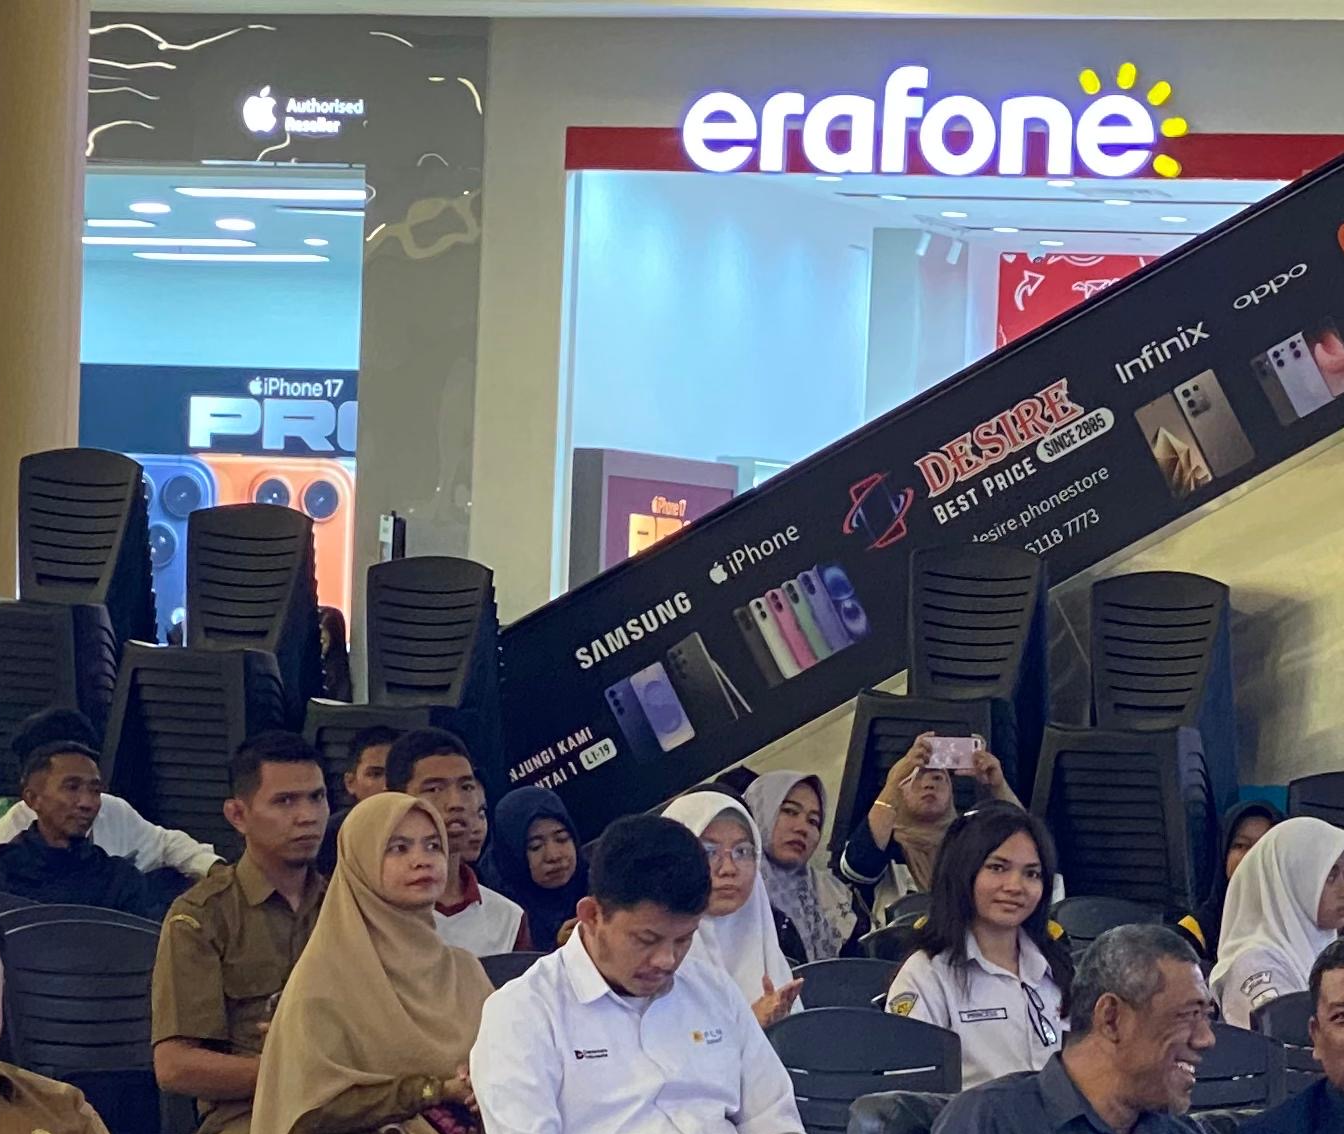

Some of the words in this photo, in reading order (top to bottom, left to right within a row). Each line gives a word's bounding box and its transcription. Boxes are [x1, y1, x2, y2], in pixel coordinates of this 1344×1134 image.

[286, 98, 364, 114] Authorised
[683, 66, 1154, 177] erafone
[1115, 322, 1210, 384] Infinix
[263, 378, 323, 397] iPhone
[324, 379, 344, 397] 17
[914, 377, 1084, 498] DESIRE
[1043, 428, 1076, 457] SINCE
[933, 488, 979, 525] BEST
[982, 457, 1037, 498] PRICE
[1063, 508, 1099, 537] 7773
[726, 525, 800, 575] iPhone
[575, 592, 692, 669] SAMSUNG
[509, 747, 556, 782] NJUNGI
[557, 726, 593, 755] KAMI
[534, 768, 567, 789] NTAI
